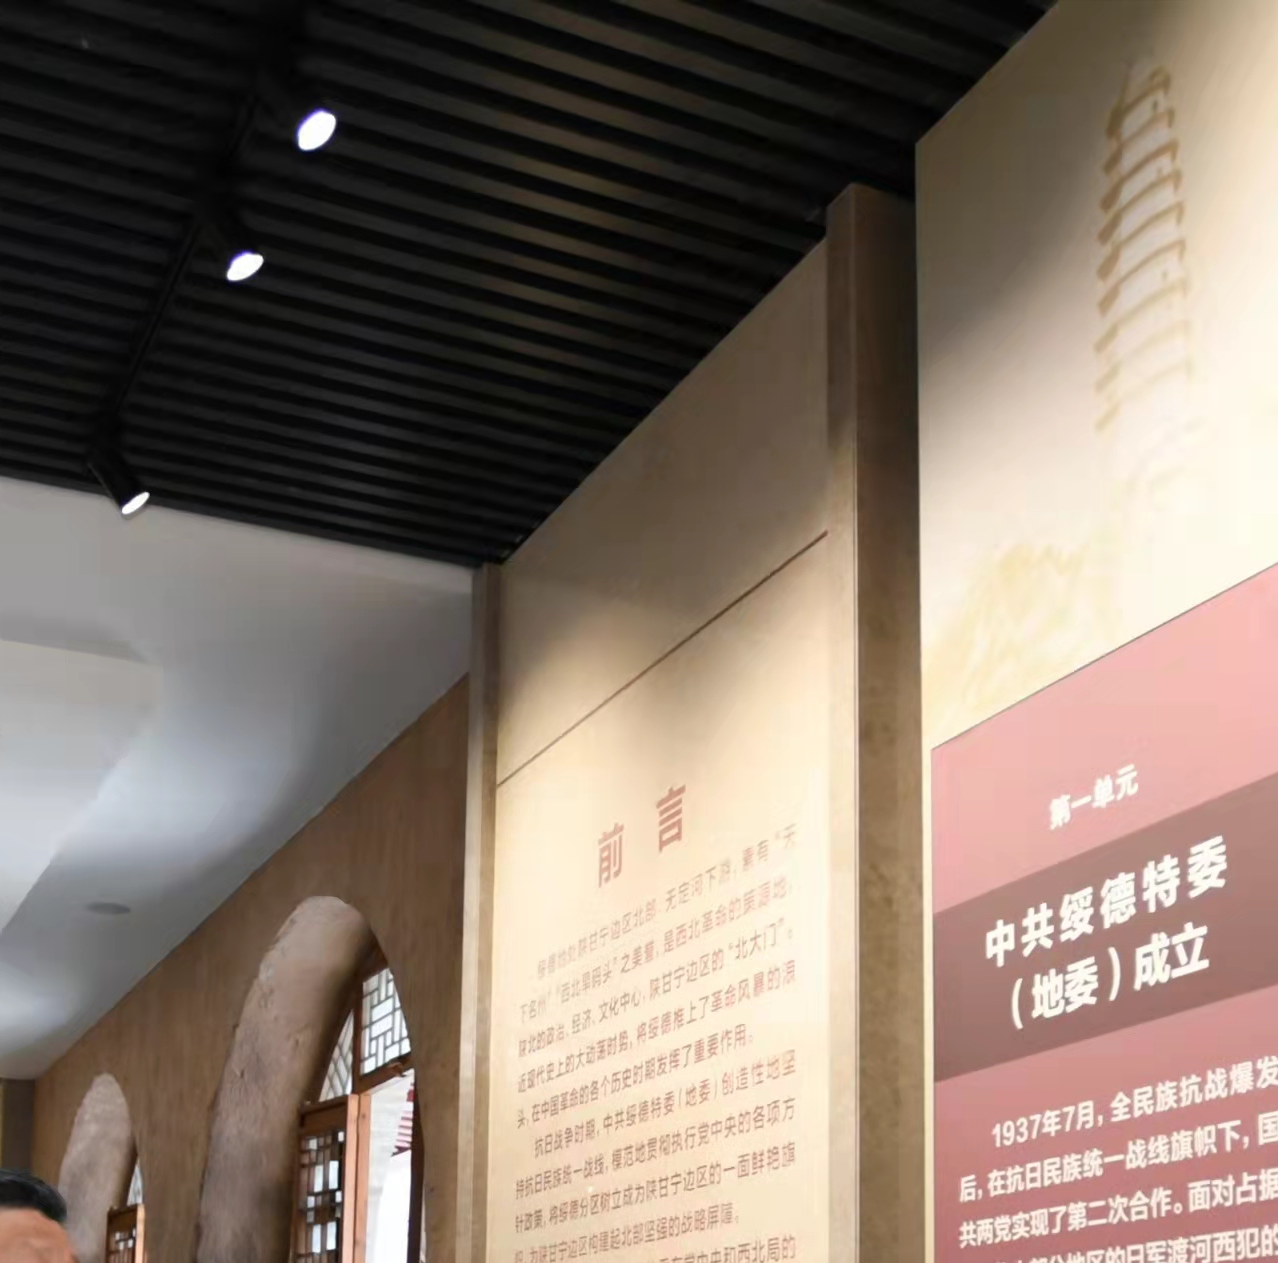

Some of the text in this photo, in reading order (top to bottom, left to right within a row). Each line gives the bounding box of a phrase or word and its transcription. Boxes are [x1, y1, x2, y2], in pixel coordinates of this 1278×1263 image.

[598, 784, 686, 888] 前言
[1049, 764, 1139, 830] 第一单元
[986, 836, 1227, 967] 中共绥德特委
[1011, 922, 1210, 1030] （地委）成立
